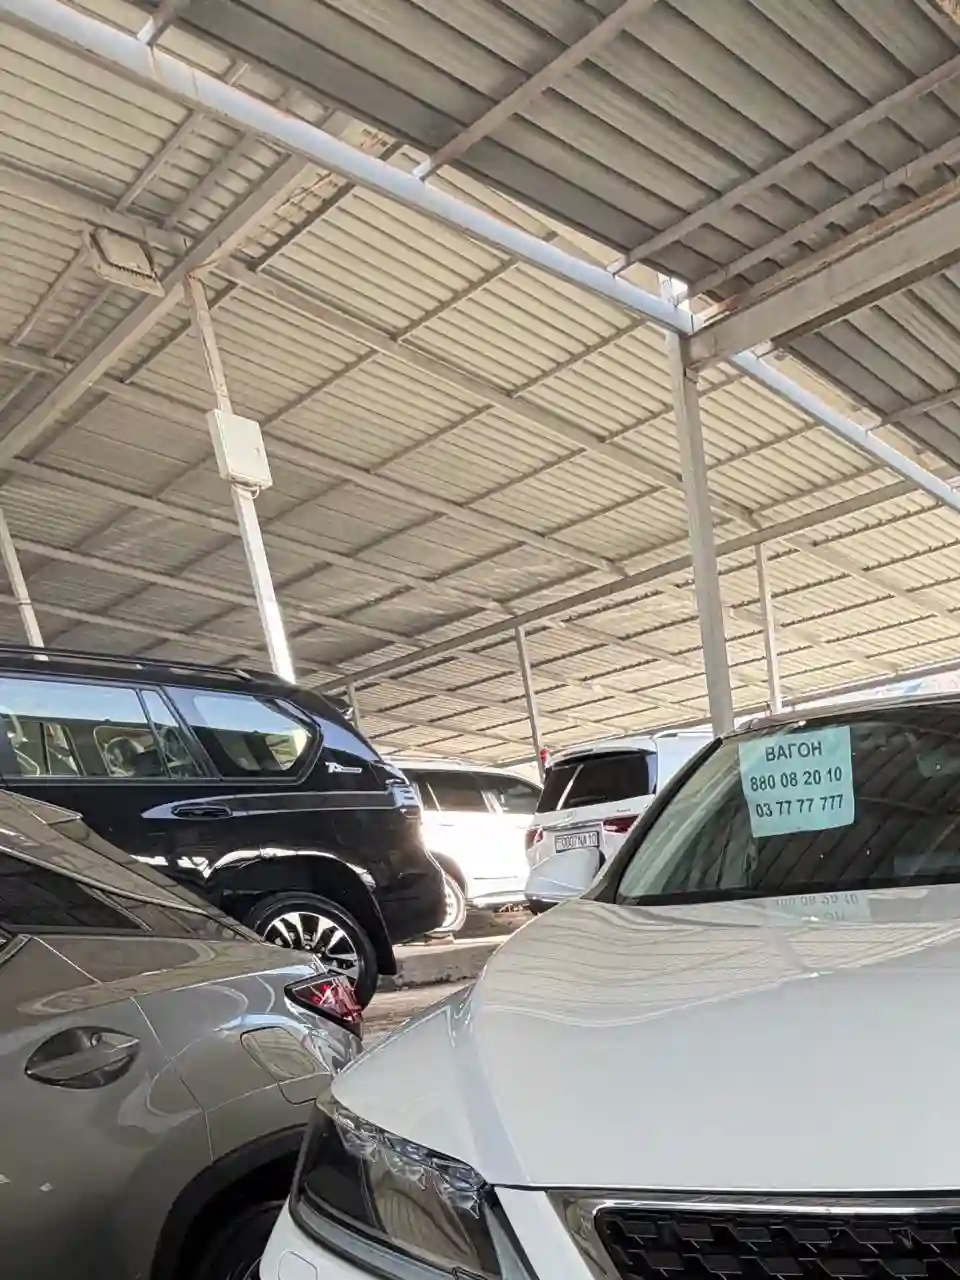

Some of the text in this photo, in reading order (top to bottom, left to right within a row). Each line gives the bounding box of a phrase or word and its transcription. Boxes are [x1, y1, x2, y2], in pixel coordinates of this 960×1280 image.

[765, 741, 823, 762] ВАГОН
[750, 766, 842, 792] 880 08 20 10
[756, 794, 843, 818] 03 77 77 777
